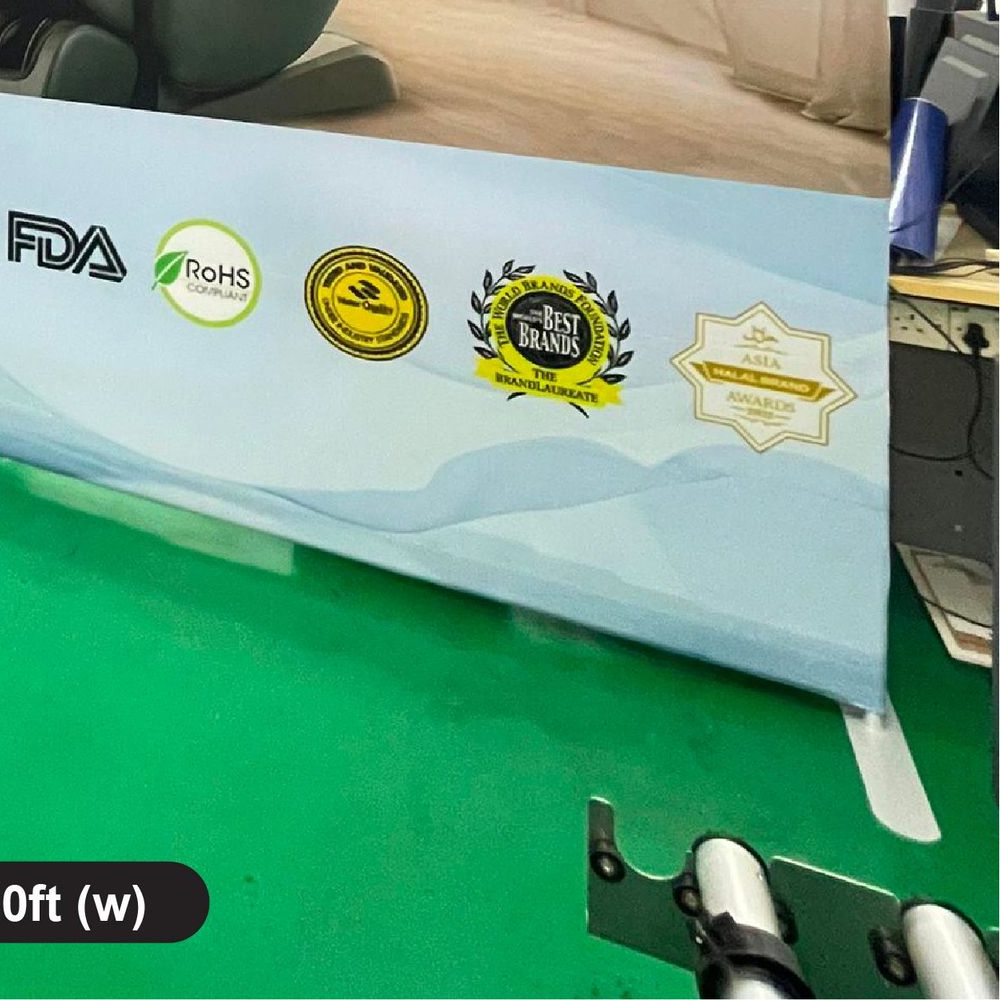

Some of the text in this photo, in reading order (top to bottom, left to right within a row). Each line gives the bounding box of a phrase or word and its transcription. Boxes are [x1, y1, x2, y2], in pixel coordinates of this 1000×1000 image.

[8, 210, 127, 284] FDA
[185, 258, 251, 290] RoHS
[493, 286, 522, 320] WORLD
[521, 279, 576, 299] BRANDS
[542, 304, 581, 336] BEST
[518, 322, 581, 359] BRANDS
[533, 367, 558, 383] THE
[740, 353, 782, 370] ASIA
[495, 371, 599, 404] BRANDLAUREATE
[726, 390, 797, 413] AWARDS
